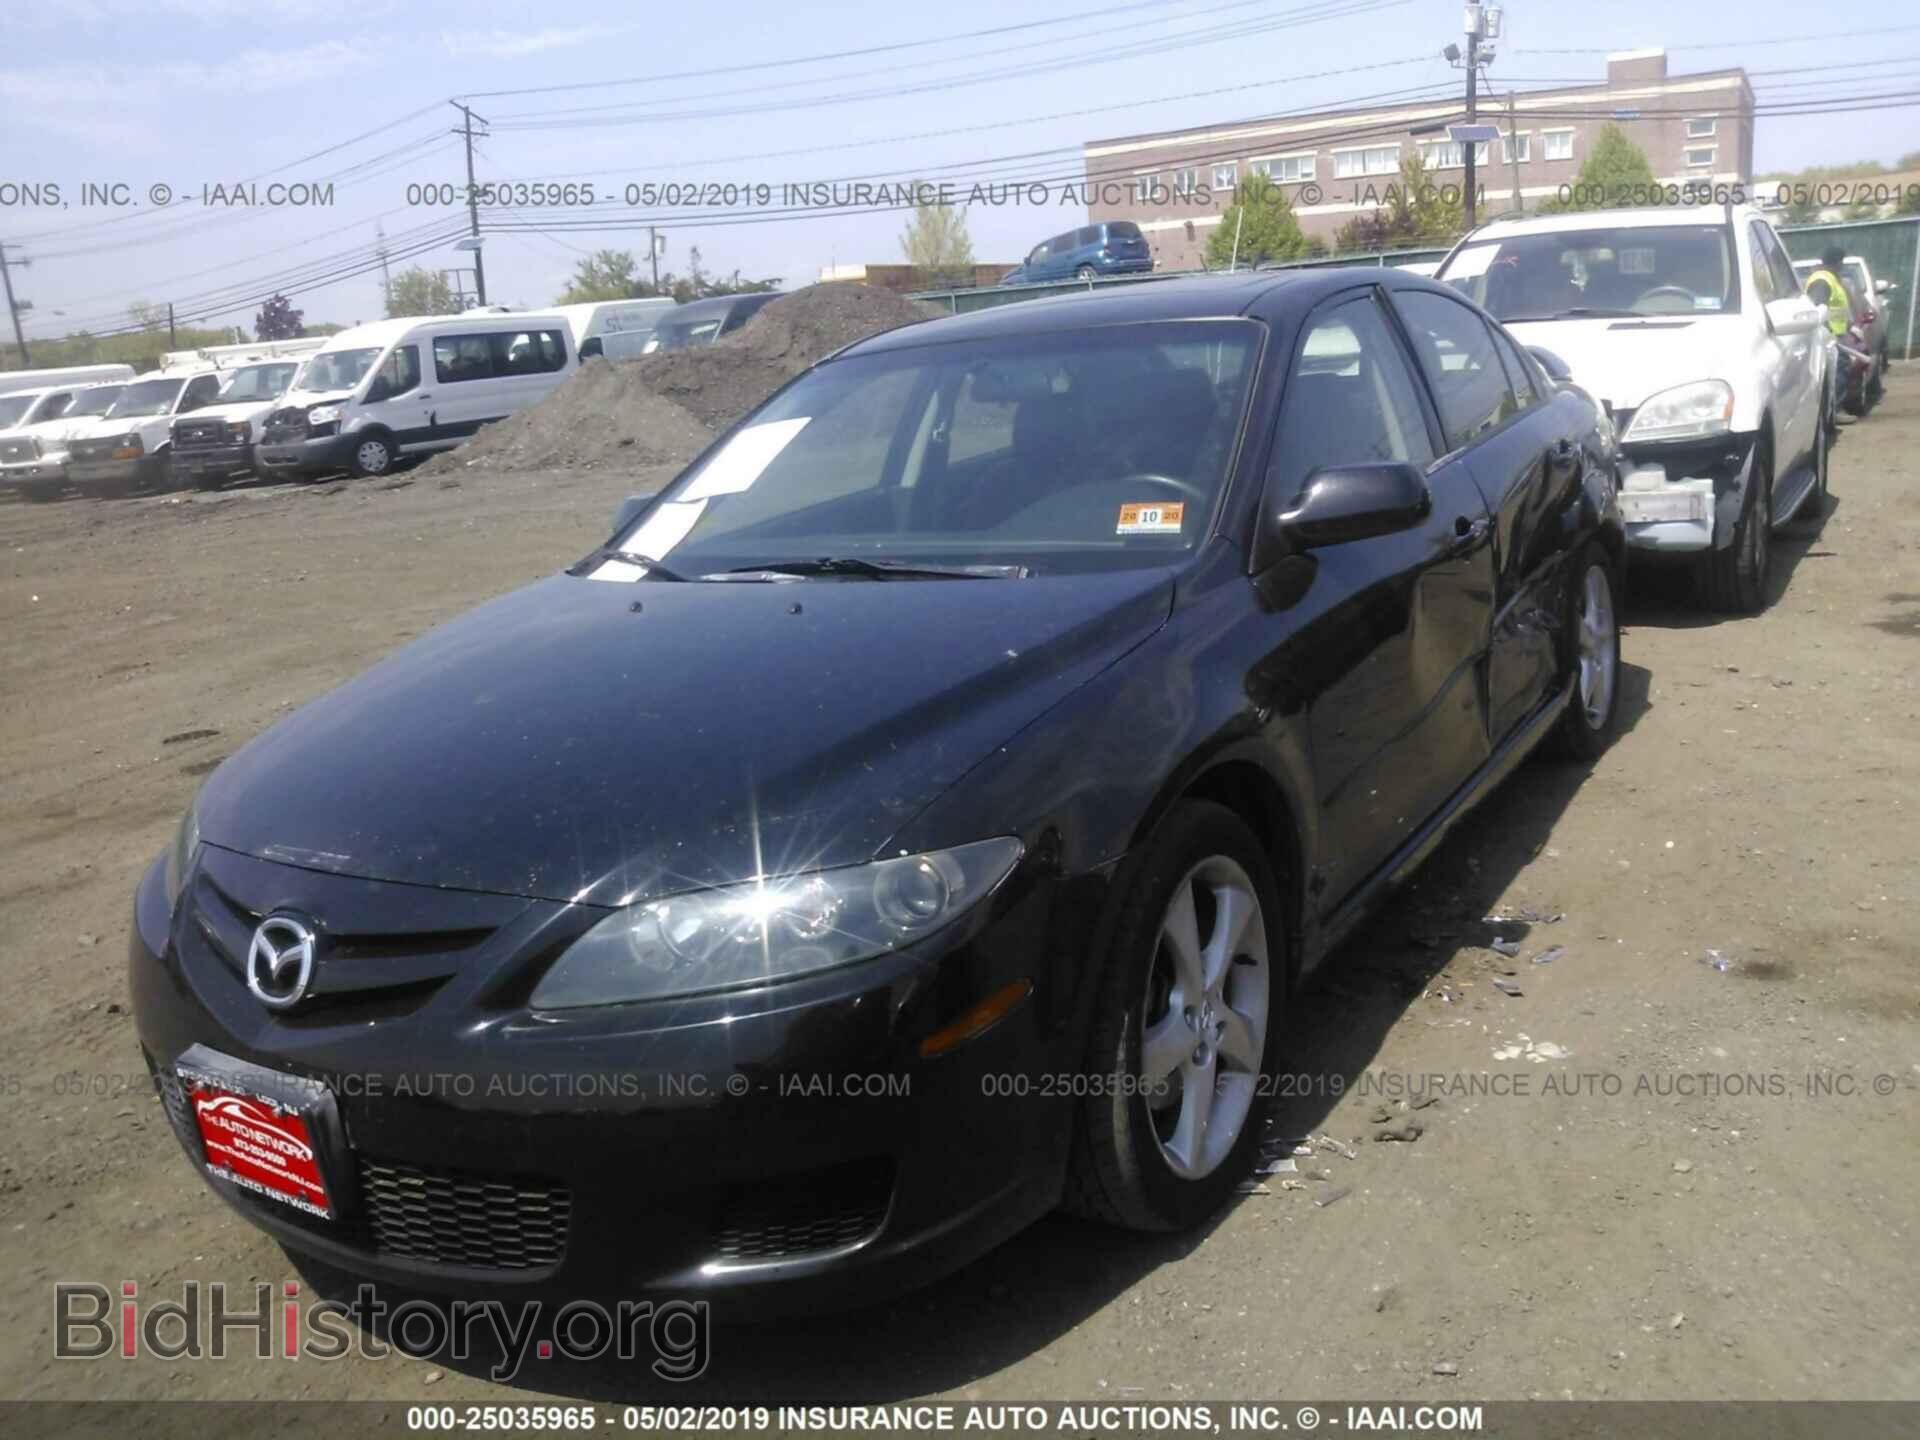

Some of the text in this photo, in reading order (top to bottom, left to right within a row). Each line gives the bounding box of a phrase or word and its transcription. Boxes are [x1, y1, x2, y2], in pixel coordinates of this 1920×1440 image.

[1143, 511, 1158, 522] 10
[205, 1161, 331, 1220] THE AUTO NETWORK
